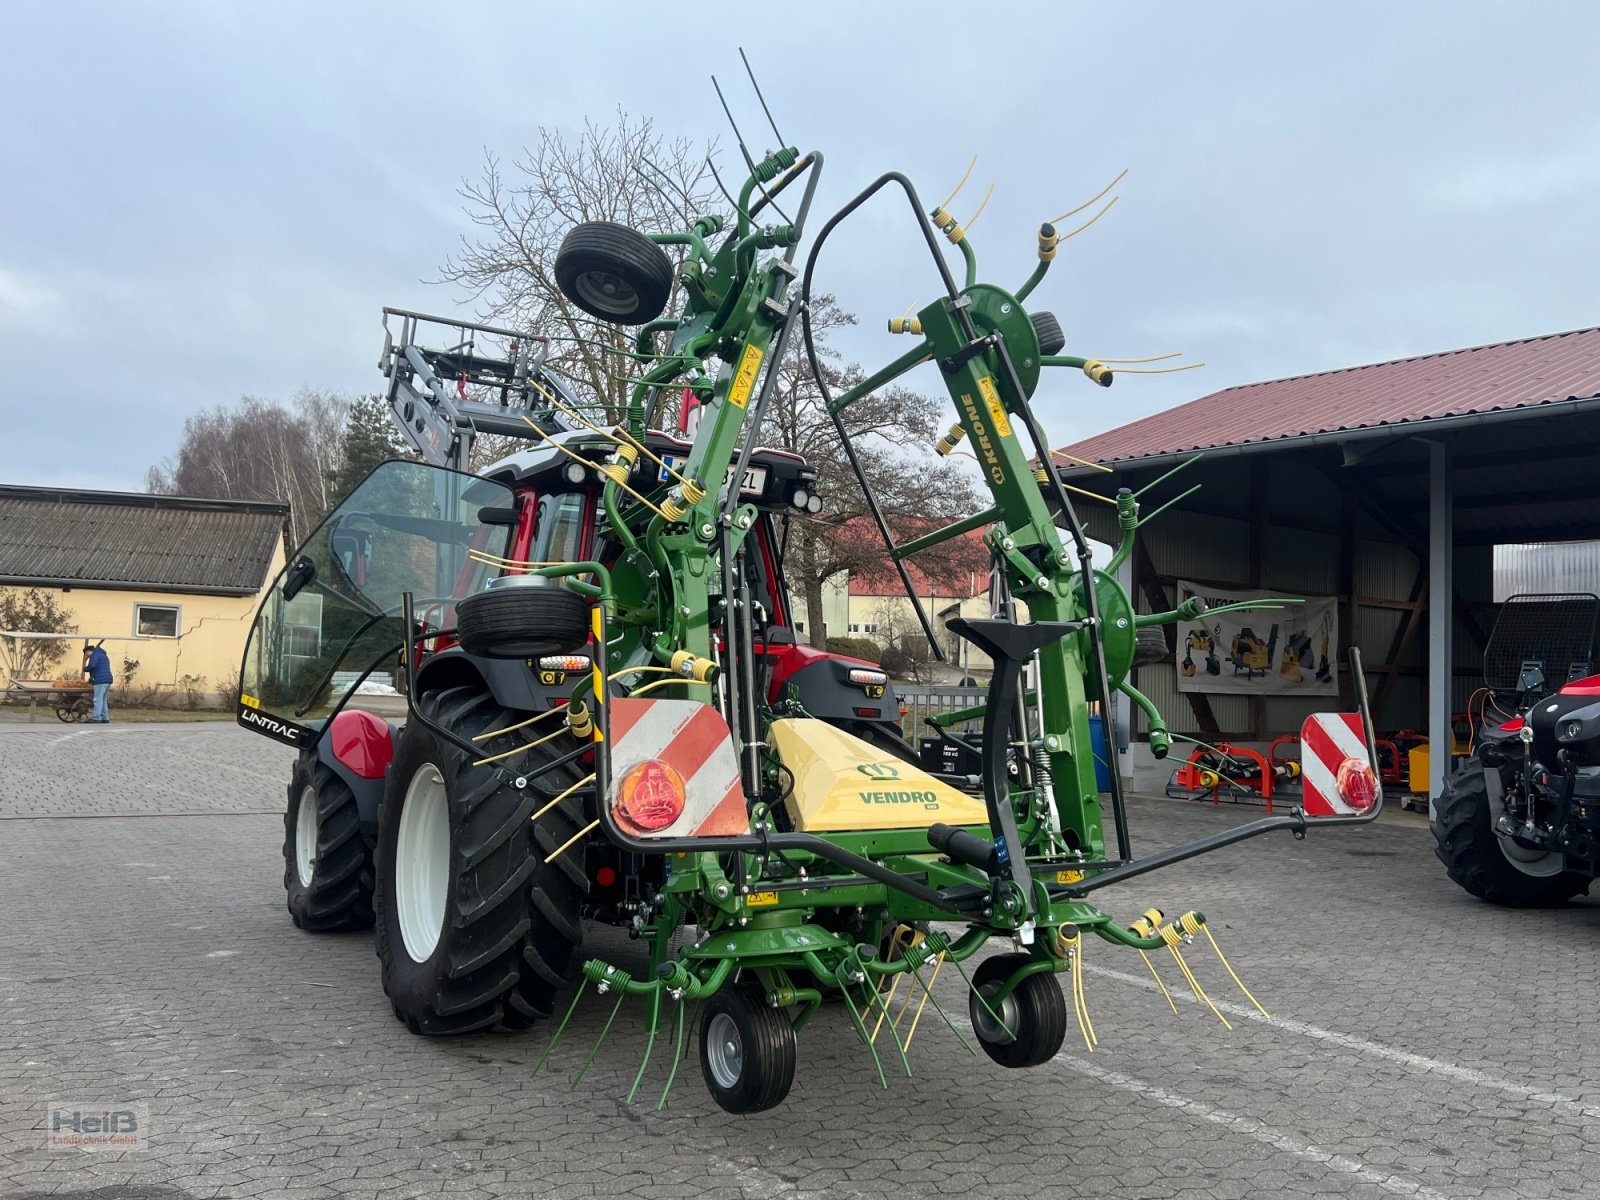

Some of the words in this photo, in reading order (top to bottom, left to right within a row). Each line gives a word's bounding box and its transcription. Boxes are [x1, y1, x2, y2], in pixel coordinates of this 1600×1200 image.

[961, 393, 998, 464] KRONE
[241, 709, 299, 739] LINTRAC
[859, 791, 937, 804] VENDRO
